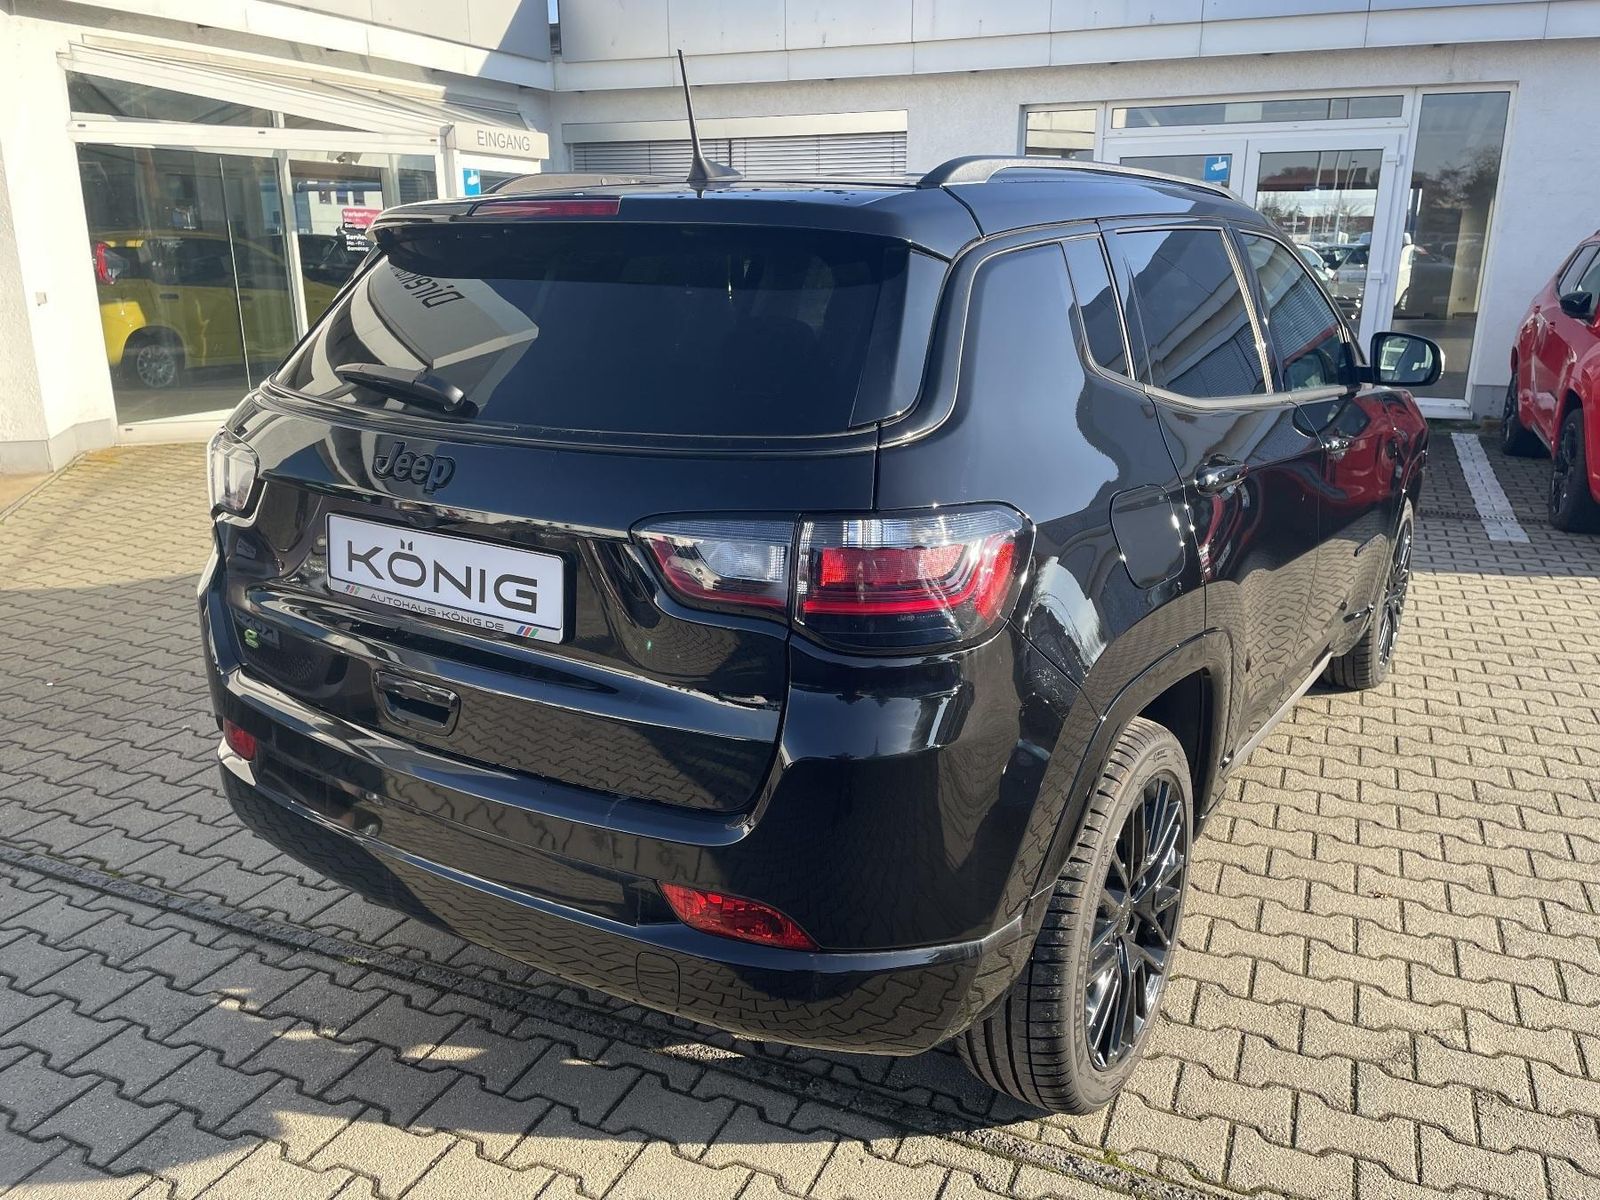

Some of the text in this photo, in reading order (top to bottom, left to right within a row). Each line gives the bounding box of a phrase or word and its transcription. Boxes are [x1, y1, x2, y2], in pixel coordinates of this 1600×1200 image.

[476, 130, 531, 151] EINGANG
[373, 441, 456, 495] Jeep
[347, 538, 538, 614] KÖNIG
